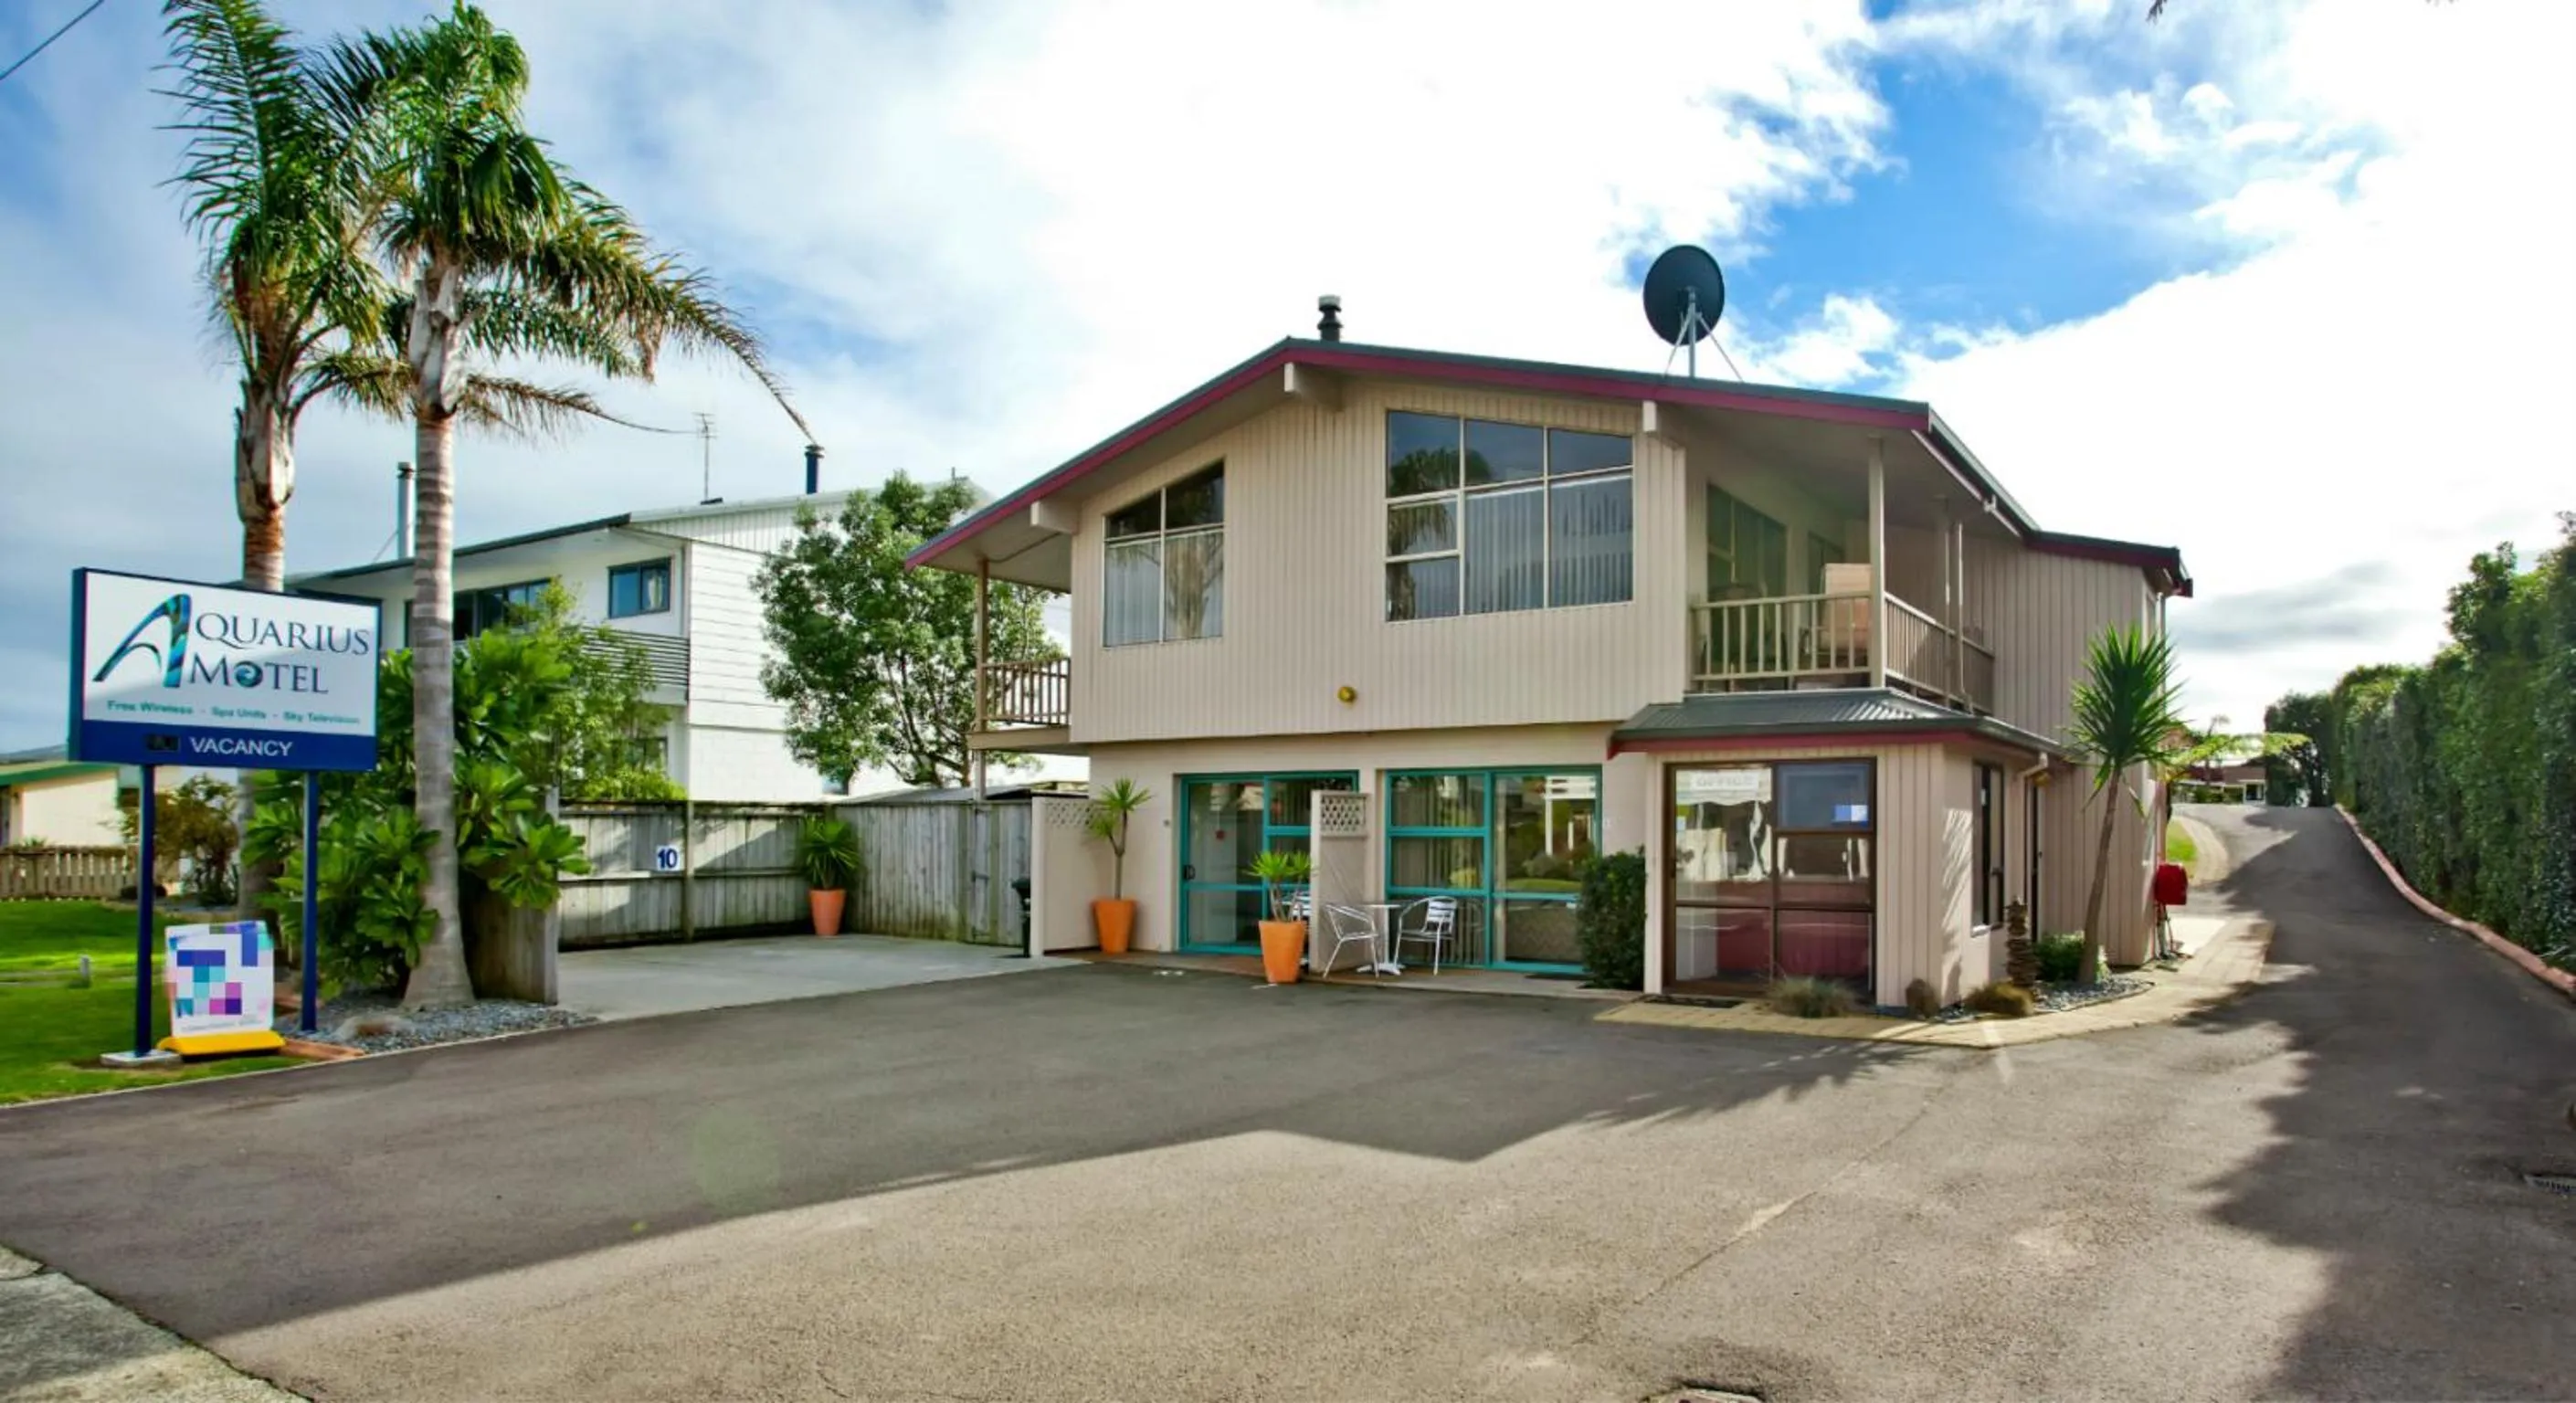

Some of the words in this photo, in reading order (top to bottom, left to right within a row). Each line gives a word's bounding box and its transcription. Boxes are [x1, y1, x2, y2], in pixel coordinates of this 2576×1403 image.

[189, 652, 329, 694] MOTEL
[189, 735, 293, 757] VACANCY
[658, 849, 678, 869] 10
